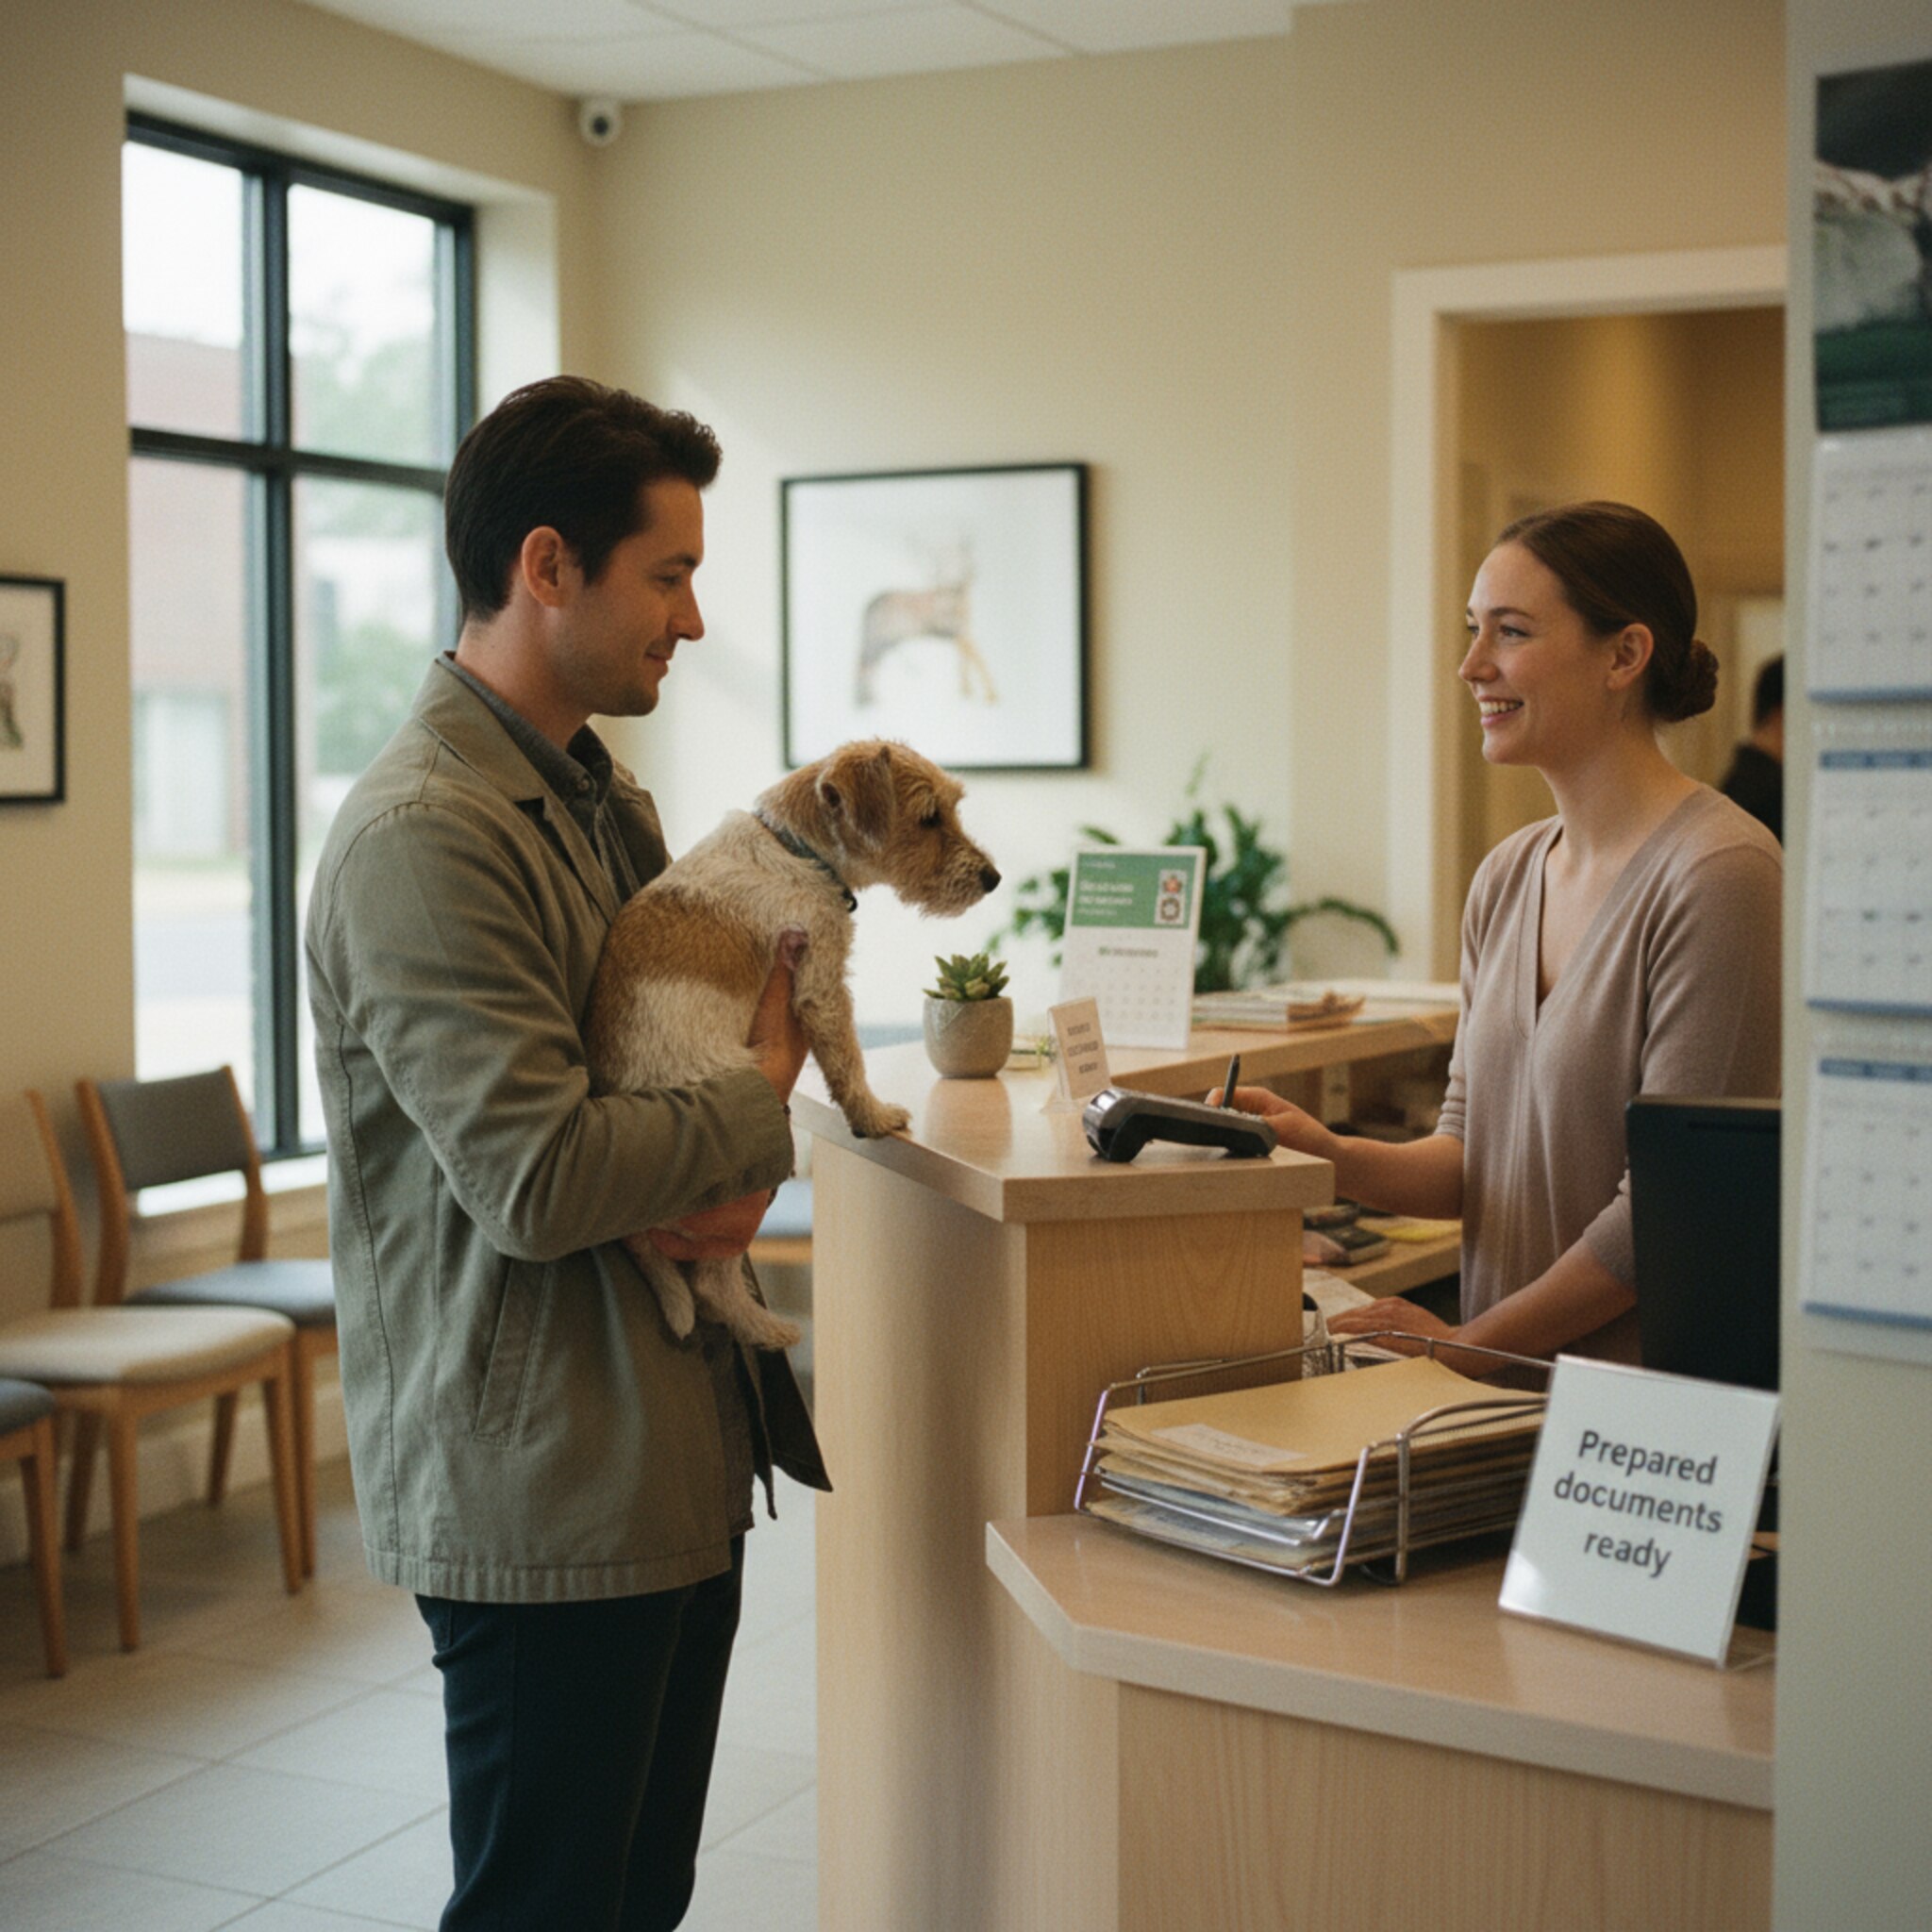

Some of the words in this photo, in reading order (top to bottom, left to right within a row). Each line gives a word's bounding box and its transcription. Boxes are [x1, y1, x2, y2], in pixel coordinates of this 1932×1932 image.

[1578, 1430, 1718, 1485] Prepared
[1554, 1472, 1723, 1533] documents
[1584, 1532, 1672, 1578] ready
